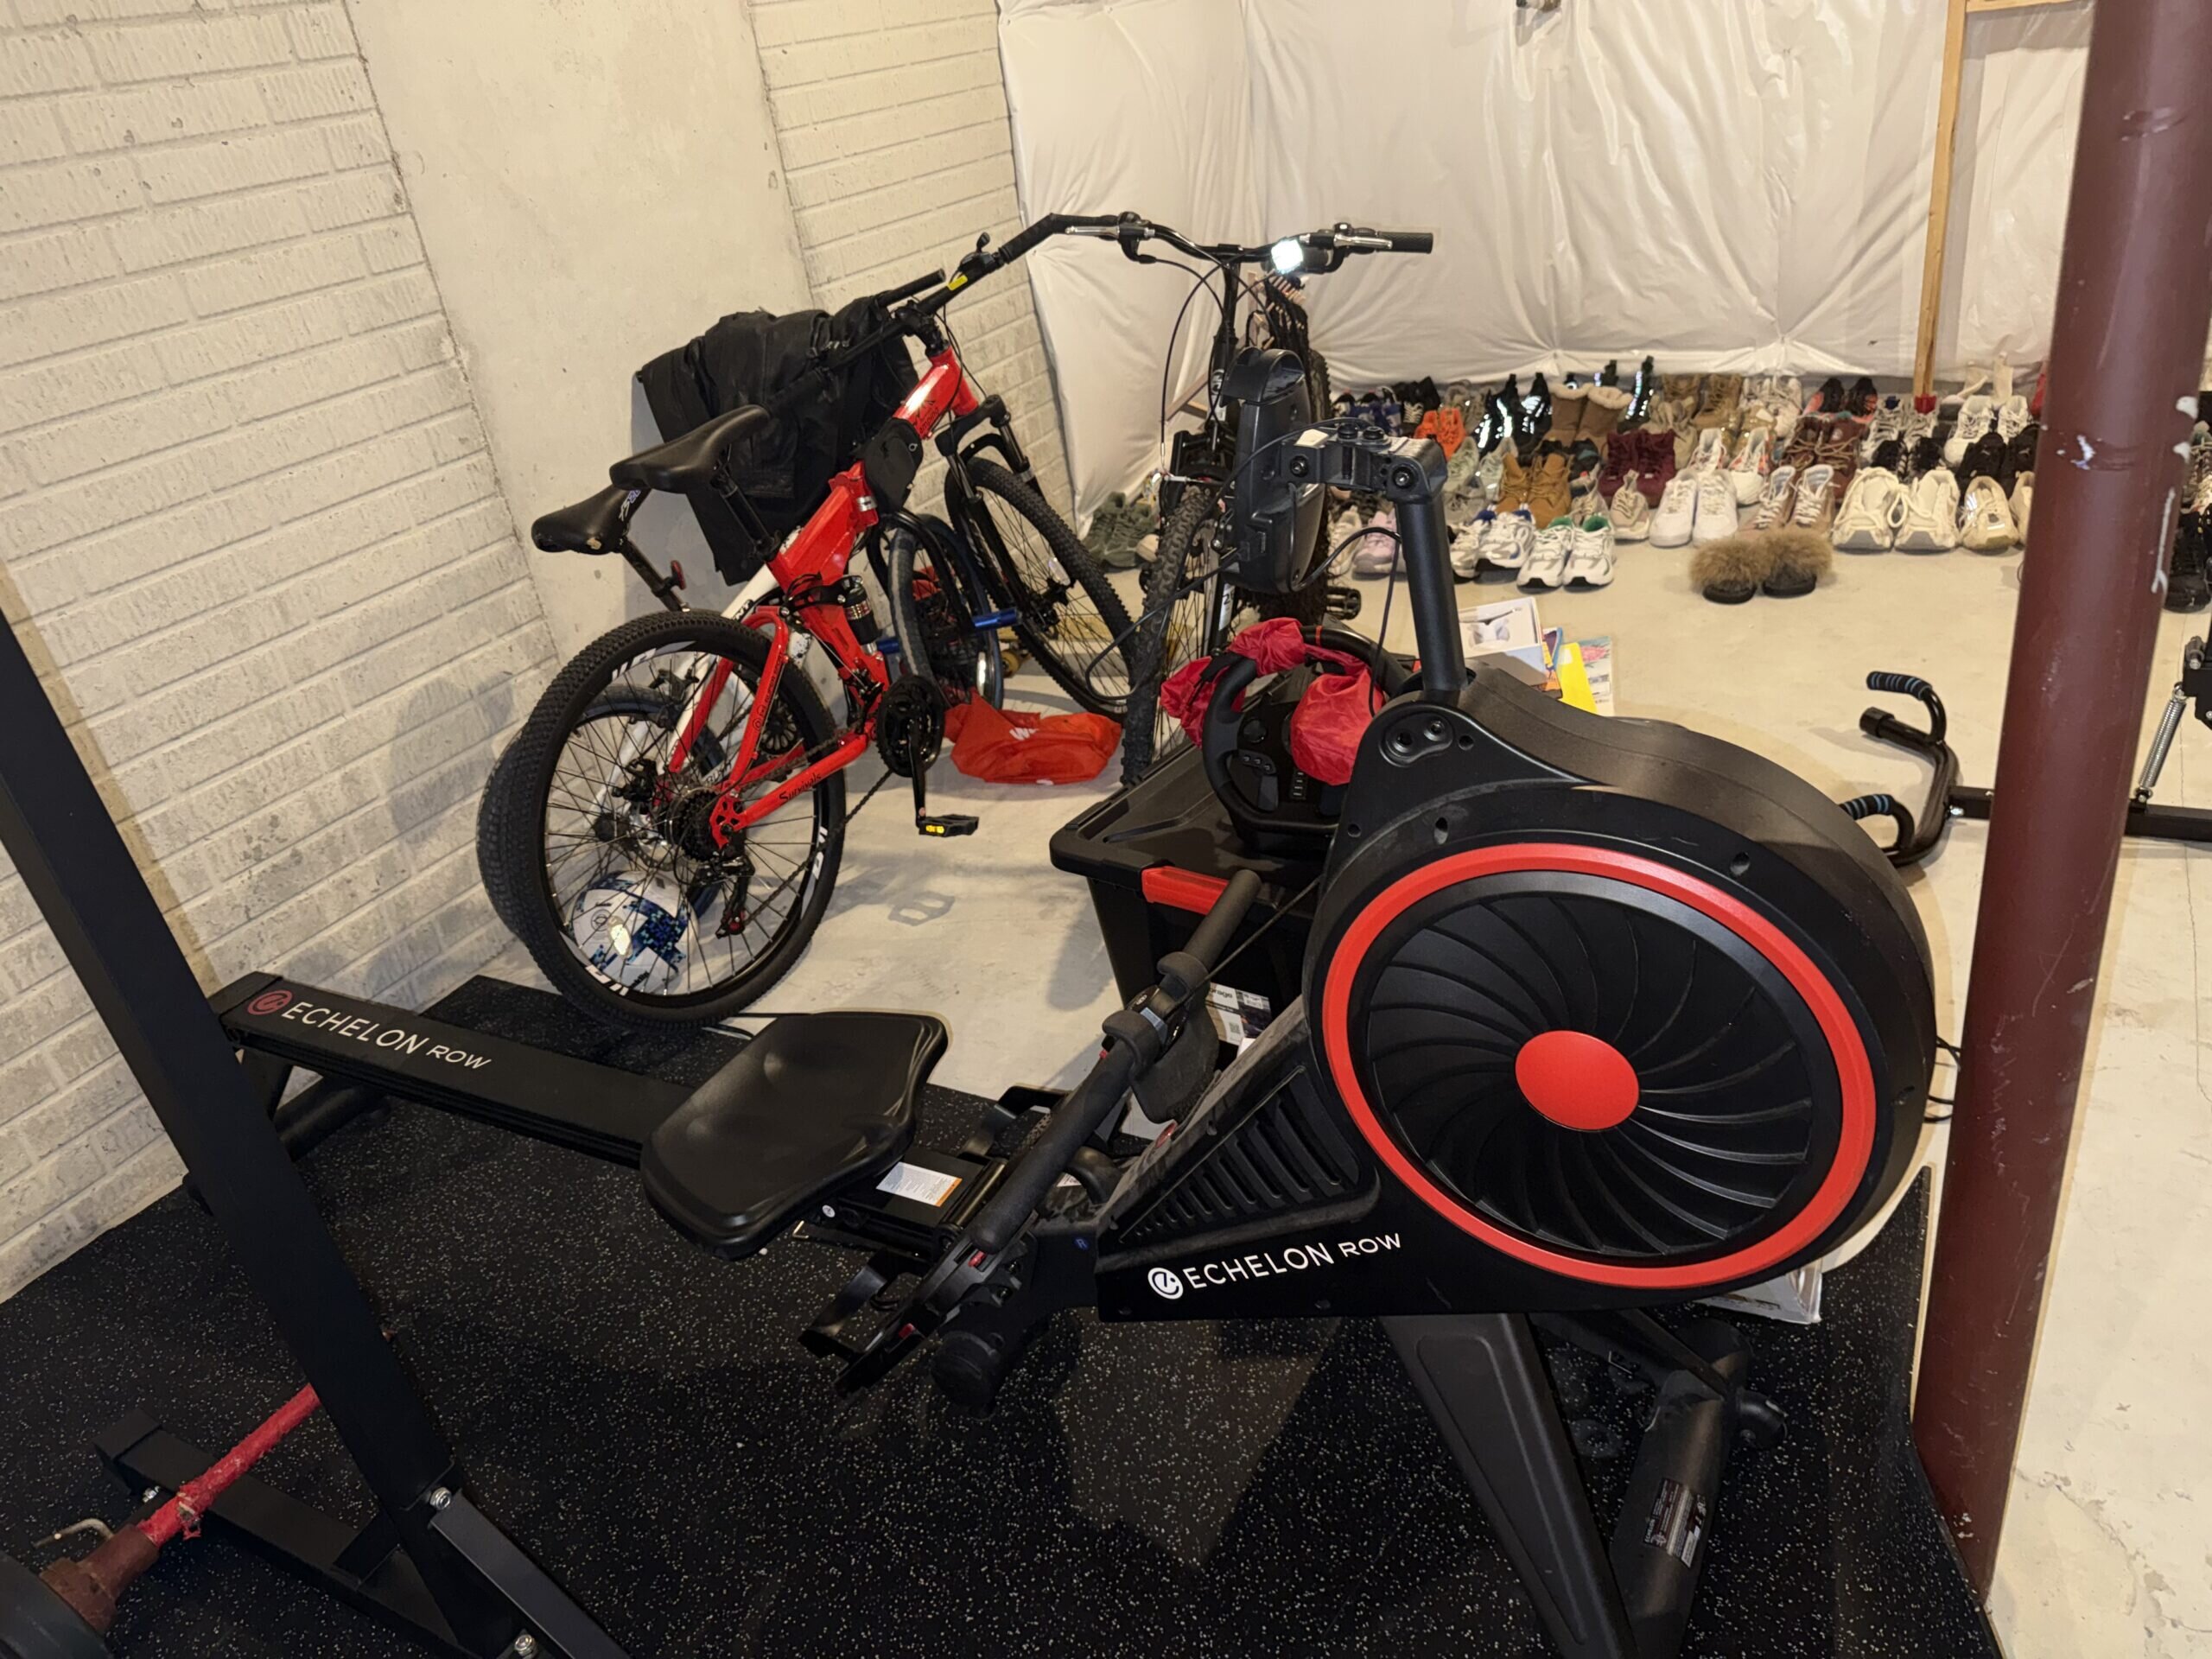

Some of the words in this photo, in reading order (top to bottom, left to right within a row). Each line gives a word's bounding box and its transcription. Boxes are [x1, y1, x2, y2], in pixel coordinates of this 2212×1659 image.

[281, 1001, 430, 1055] ECHELON
[426, 1044, 492, 1070] ROW
[1183, 1243, 1335, 1289] ECHELON
[1338, 1233, 1402, 1257] ROW
